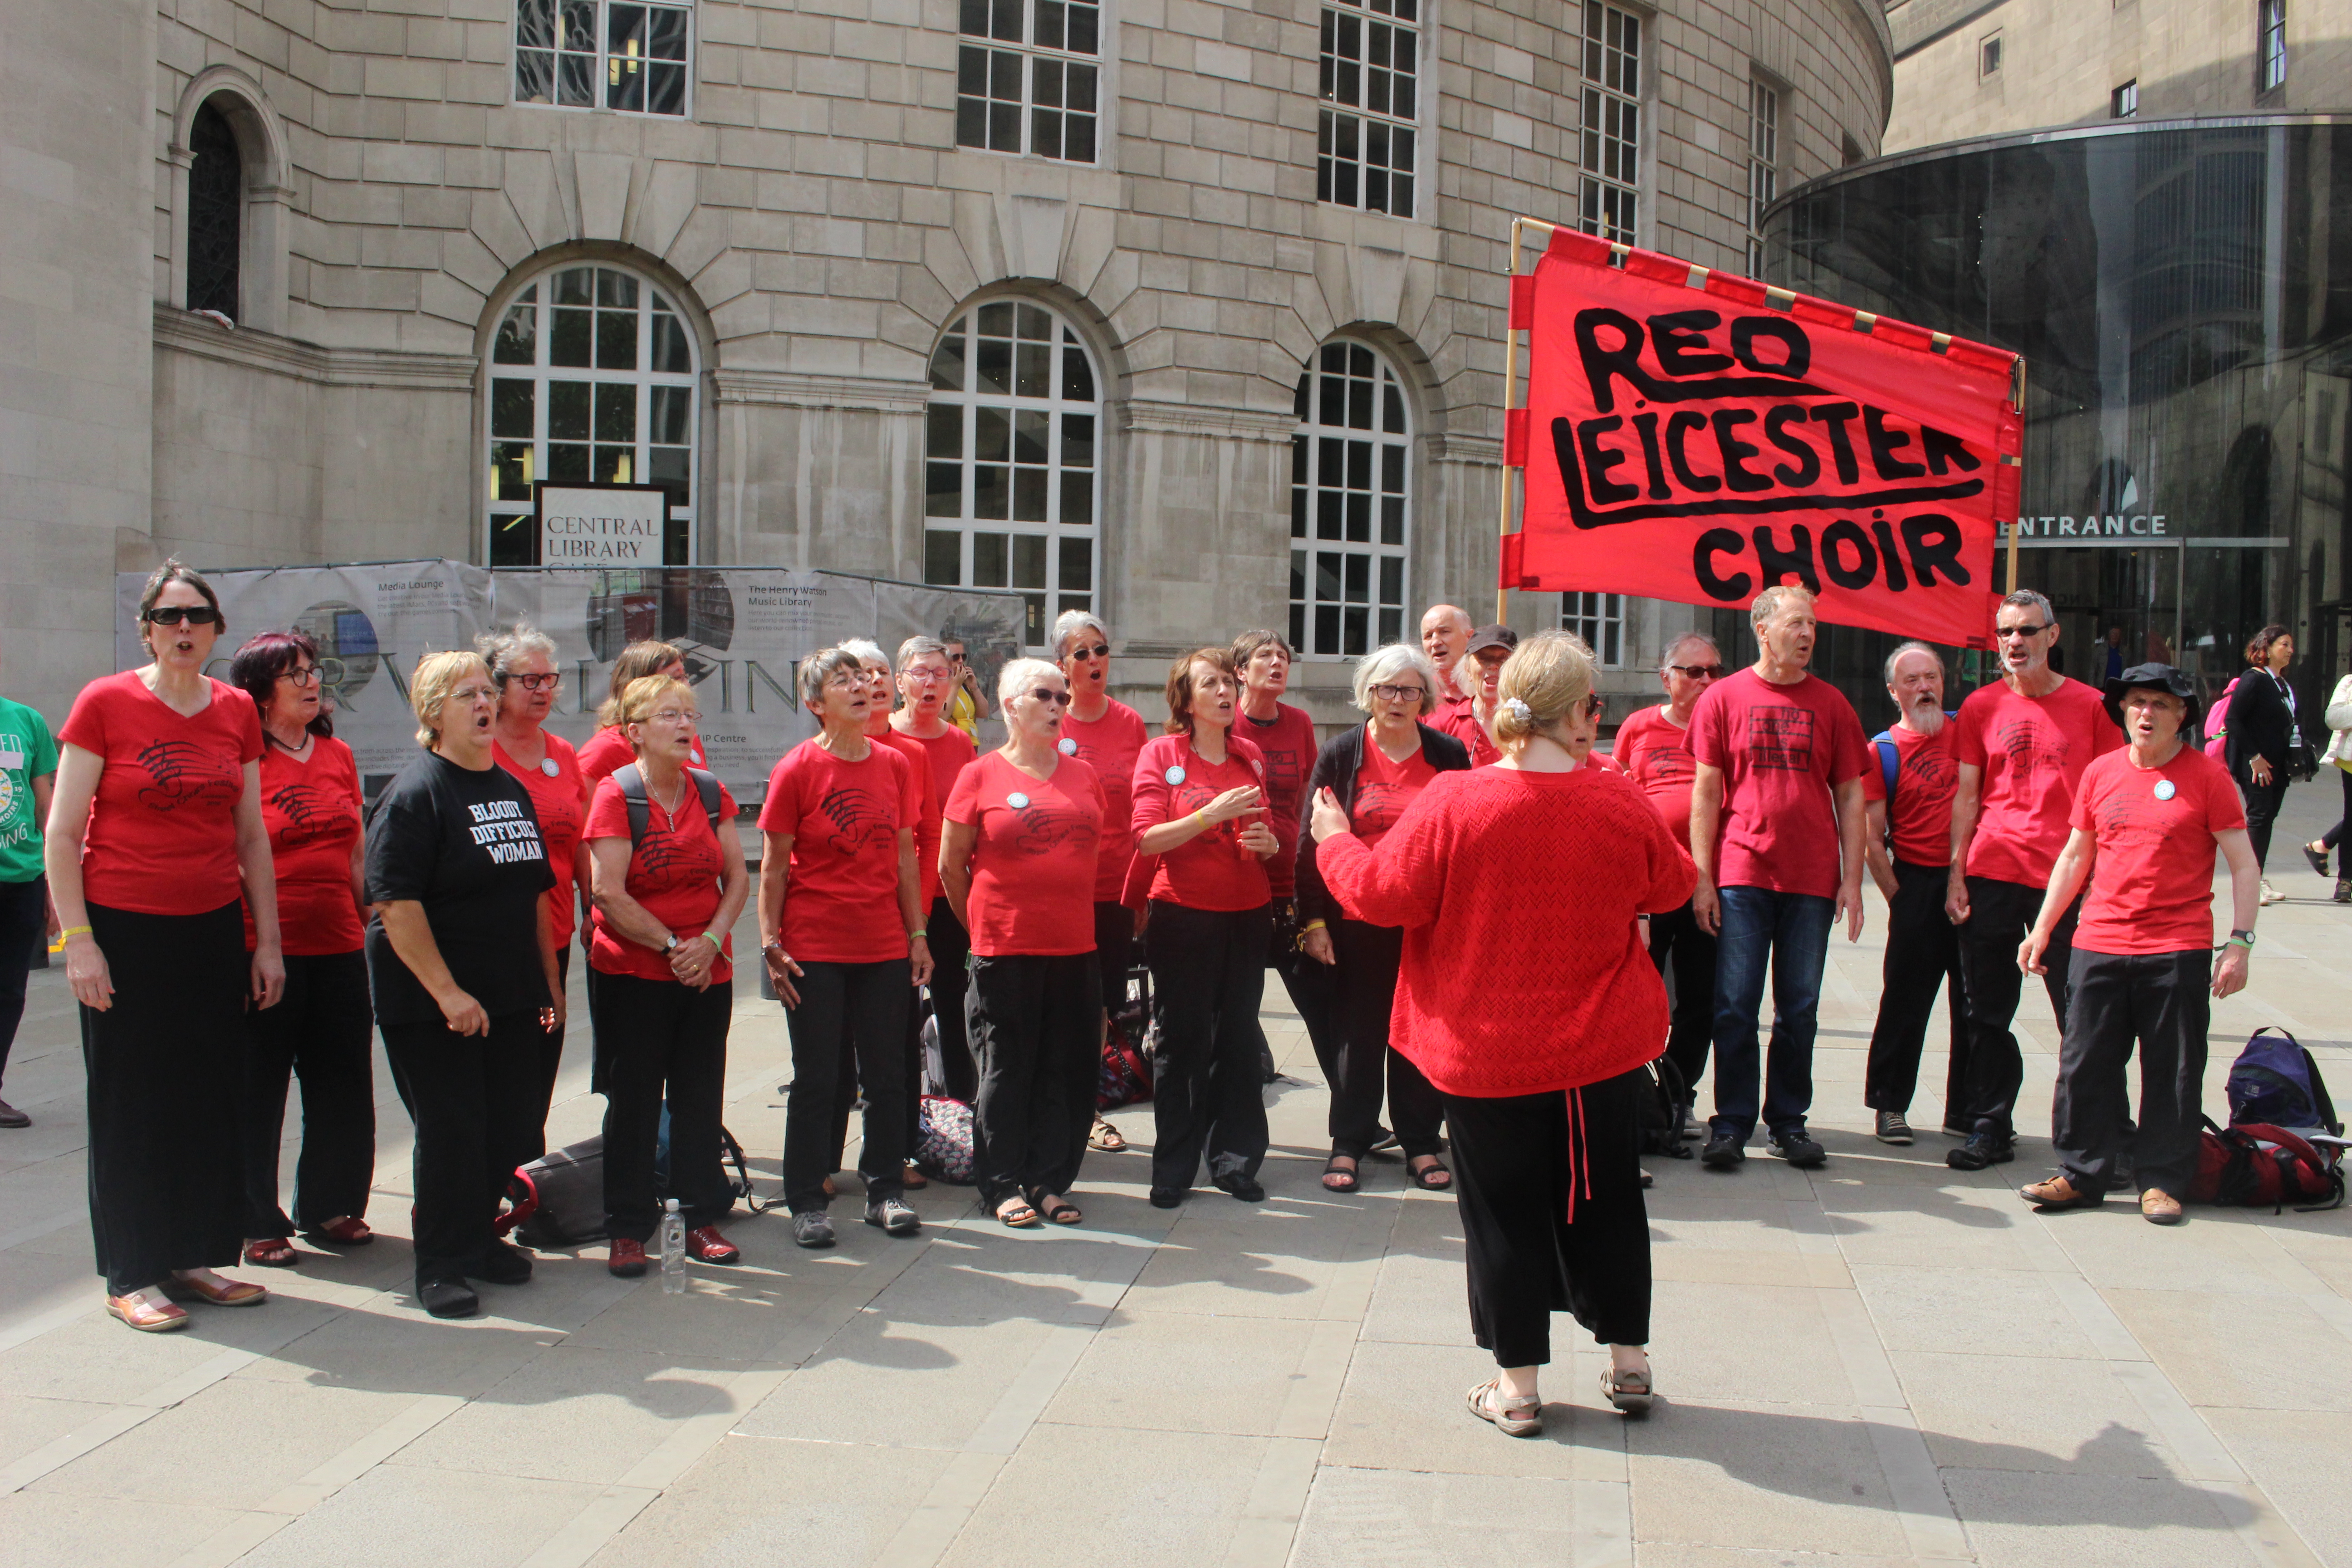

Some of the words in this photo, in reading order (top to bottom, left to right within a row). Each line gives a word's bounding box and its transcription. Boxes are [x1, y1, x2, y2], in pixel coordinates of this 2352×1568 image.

[1574, 308, 1849, 414] RED
[547, 516, 658, 536] CENTRAL
[1999, 515, 2166, 536] ENTRANCE
[549, 539, 642, 558] LIBRARY
[378, 582, 406, 591] Media
[409, 580, 444, 590] Lounge
[749, 585, 766, 593] The
[769, 586, 798, 596] Henry
[800, 586, 827, 596] Watson
[749, 597, 777, 606] Music
[779, 597, 812, 608] Library
[1782, 708, 1800, 720] no
[1762, 720, 1789, 733] one
[714, 735, 746, 743] Centre
[1759, 750, 1800, 767] illegal
[468, 800, 523, 823] BLOODY
[469, 820, 539, 845] DIFFICULT
[486, 841, 543, 864] WOMAN
